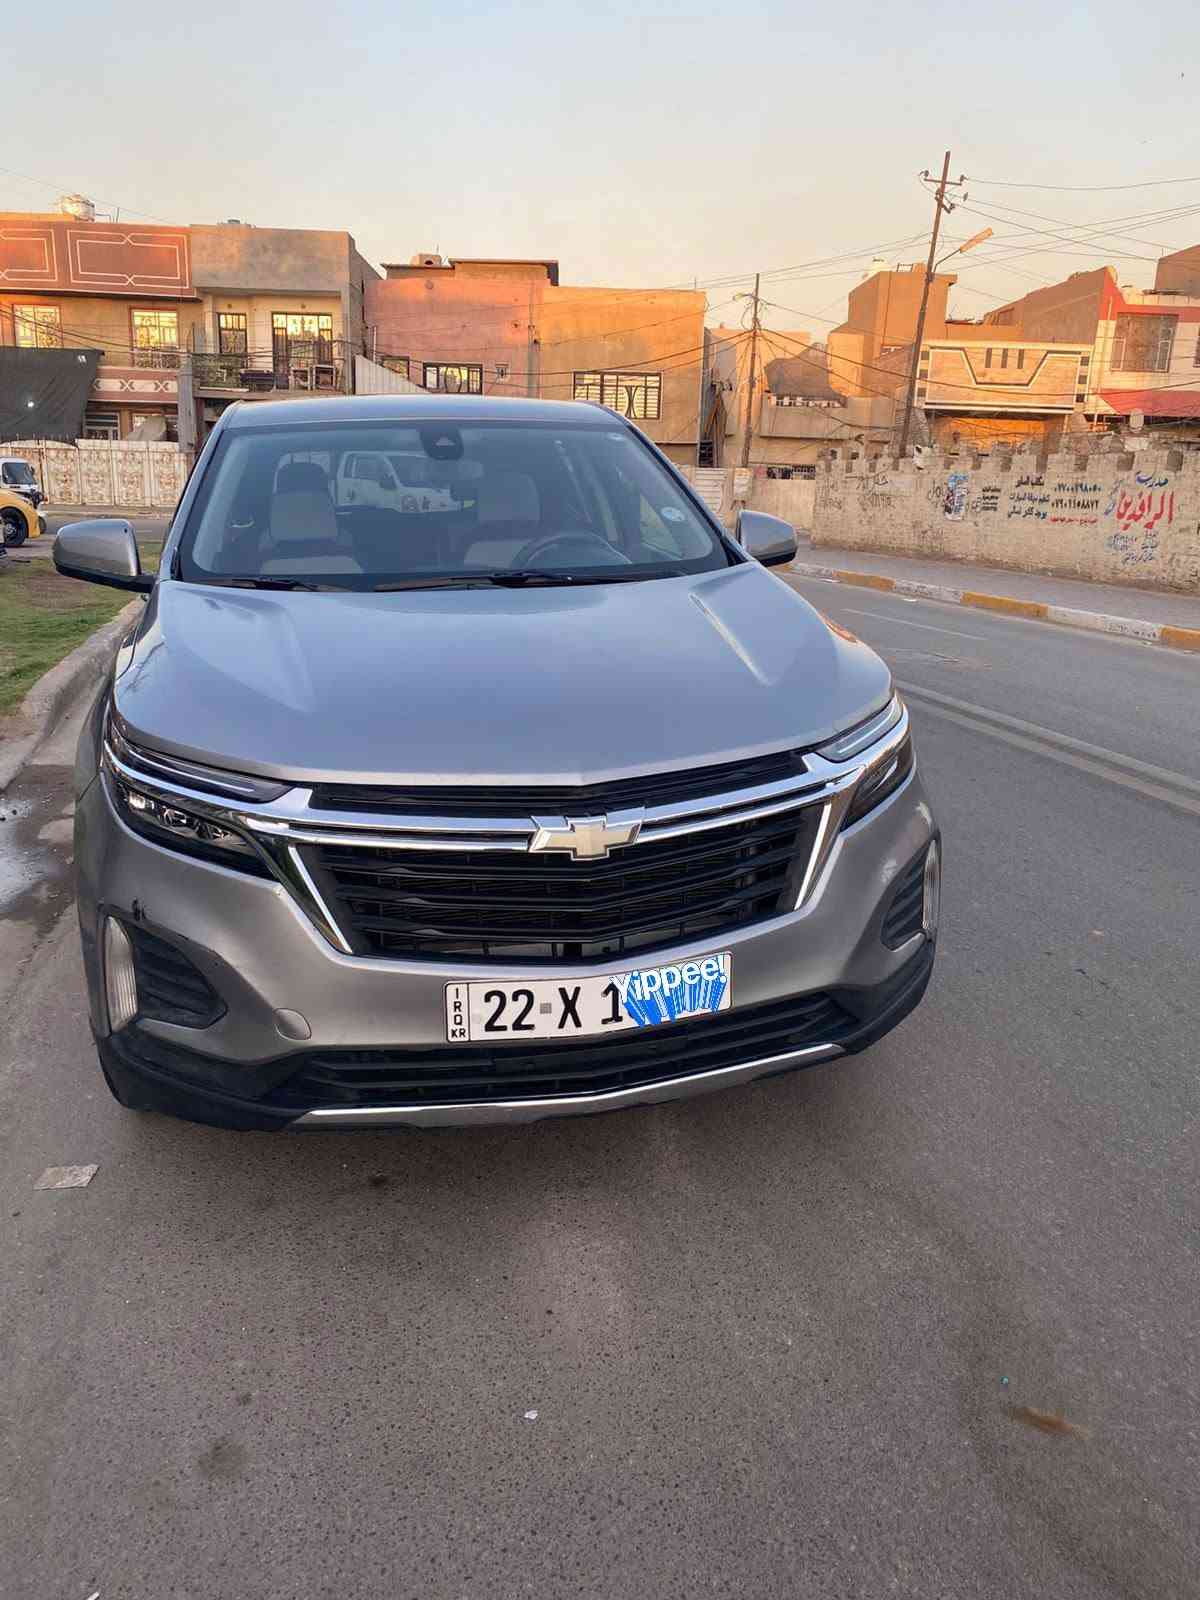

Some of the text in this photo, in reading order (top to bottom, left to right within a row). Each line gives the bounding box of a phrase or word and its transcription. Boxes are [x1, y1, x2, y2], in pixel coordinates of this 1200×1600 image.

[1117, 491, 1174, 531] الرافدين
[484, 989, 535, 1032] 22
[558, 986, 582, 1029] X
[451, 1028, 466, 1038] KR
